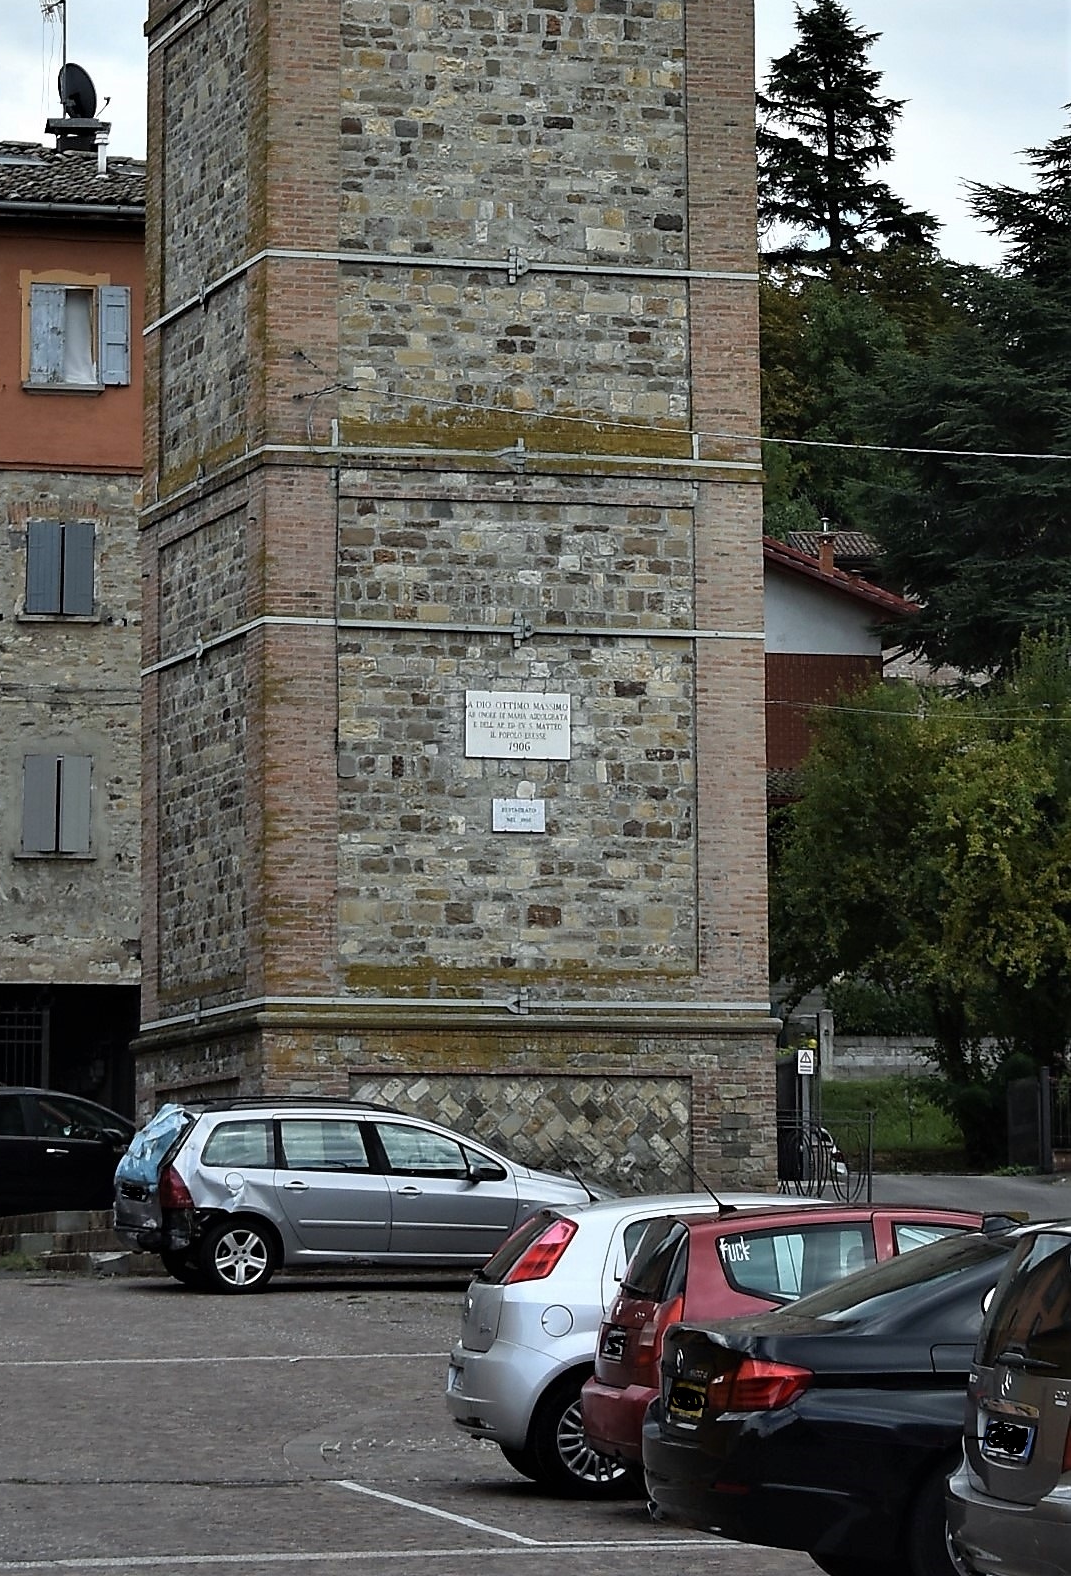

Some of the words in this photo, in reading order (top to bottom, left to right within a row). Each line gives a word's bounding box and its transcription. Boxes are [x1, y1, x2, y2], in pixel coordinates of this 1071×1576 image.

[496, 701, 529, 710] OTTIMO
[533, 703, 569, 711] MASSIMO
[508, 712, 527, 720] MARIA
[536, 723, 563, 731] MATTEO
[498, 731, 523, 739] POPOLO
[508, 741, 531, 752] 1906
